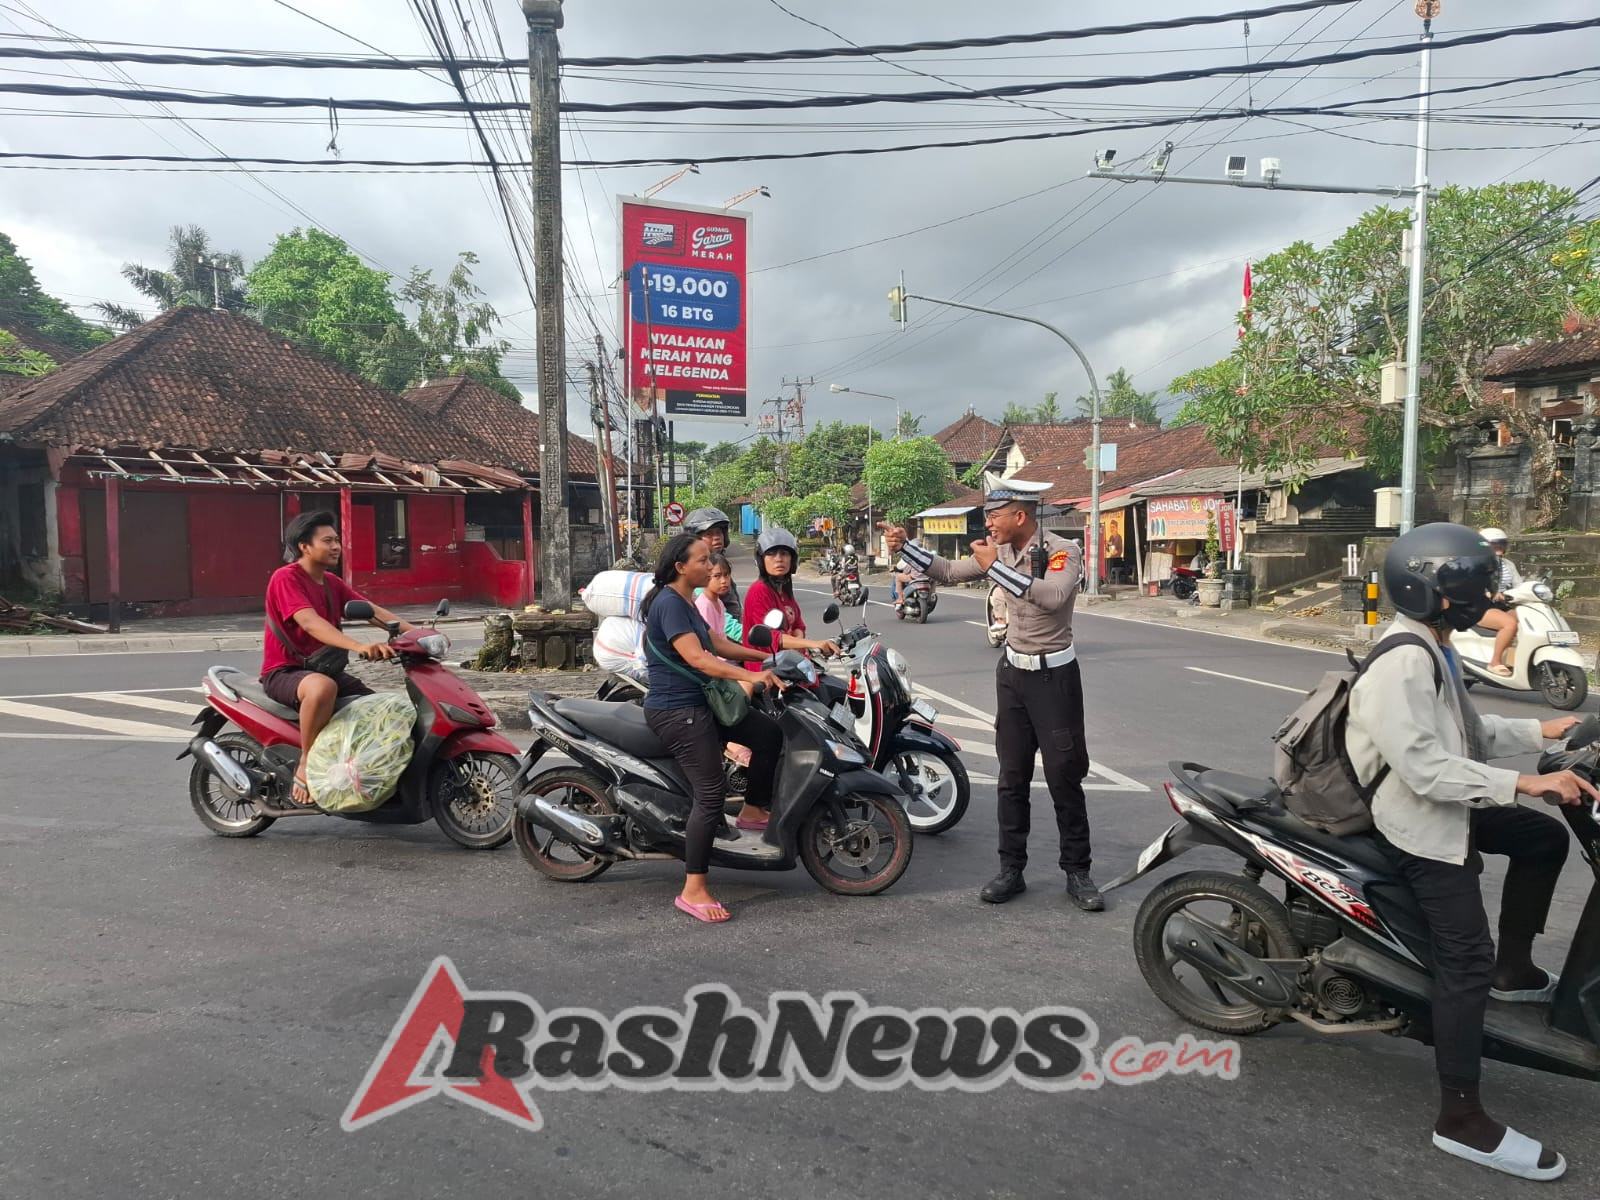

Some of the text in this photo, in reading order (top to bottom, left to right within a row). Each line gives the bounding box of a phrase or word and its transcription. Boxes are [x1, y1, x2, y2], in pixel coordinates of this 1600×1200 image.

[691, 227, 733, 249] Garam
[691, 250, 733, 261] MERAH
[661, 304, 714, 321] 16 BTG
[649, 333, 726, 350] NYALAKAN
[640, 347, 733, 366] MERAH YANG
[644, 363, 729, 380] MELEGENDA
[1150, 499, 1190, 513] SAHABAT
[1220, 503, 1233, 511] JOK
[1223, 512, 1232, 549] SADEL
[543, 728, 569, 752] YAMAHA
